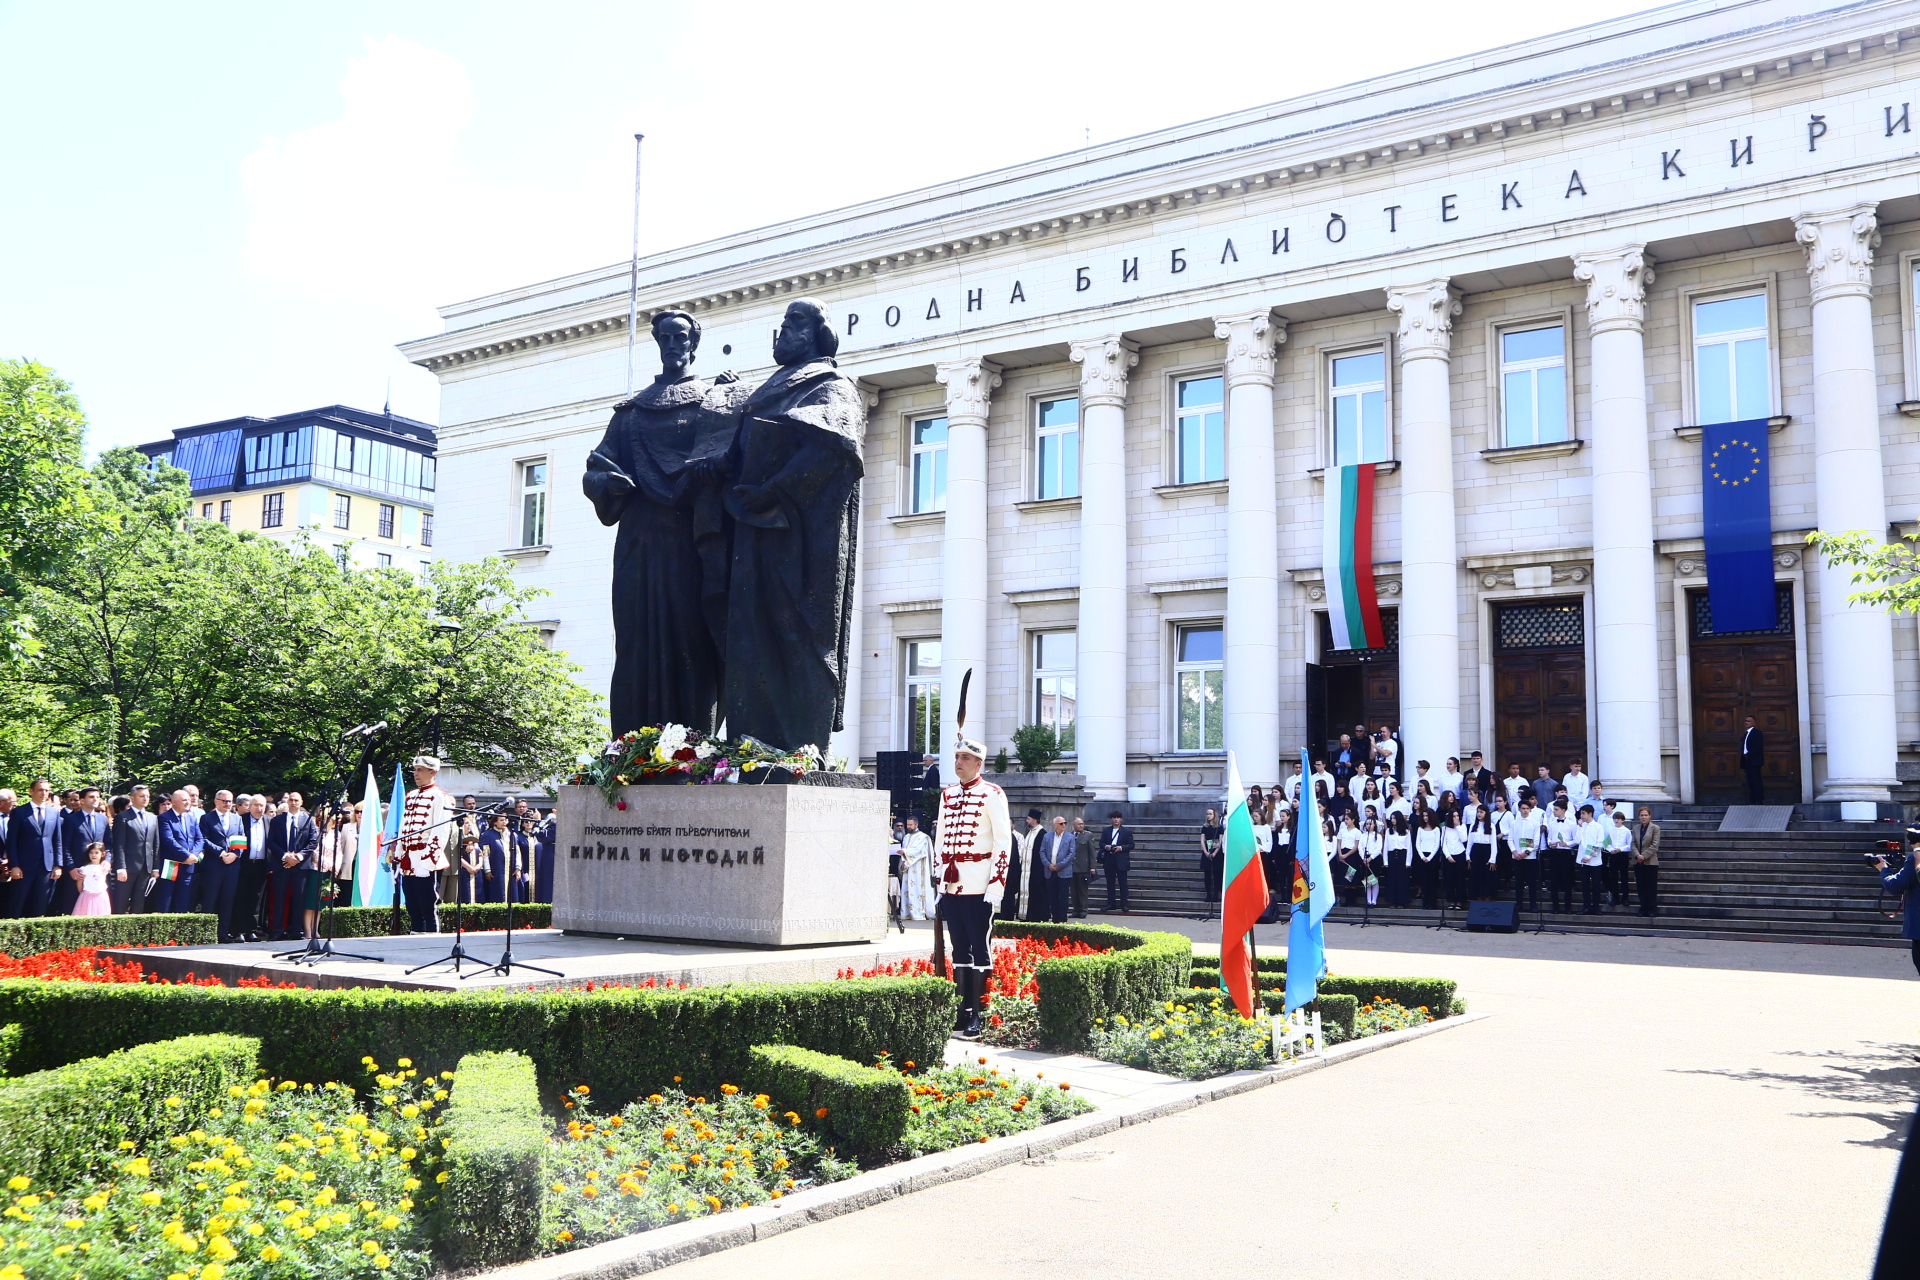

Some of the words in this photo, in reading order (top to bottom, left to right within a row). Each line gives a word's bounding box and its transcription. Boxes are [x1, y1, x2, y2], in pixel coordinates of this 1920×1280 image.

[772, 280, 1026, 350] РОДНА
[1075, 169, 1587, 292] БИБЛИОТЕКА
[1661, 102, 1911, 180] КИРИ
[646, 823, 672, 836] БРАТЯ
[570, 841, 630, 861] КИРИЛ
[639, 847, 651, 862] И
[661, 845, 764, 868] МЕТОДИЙ
